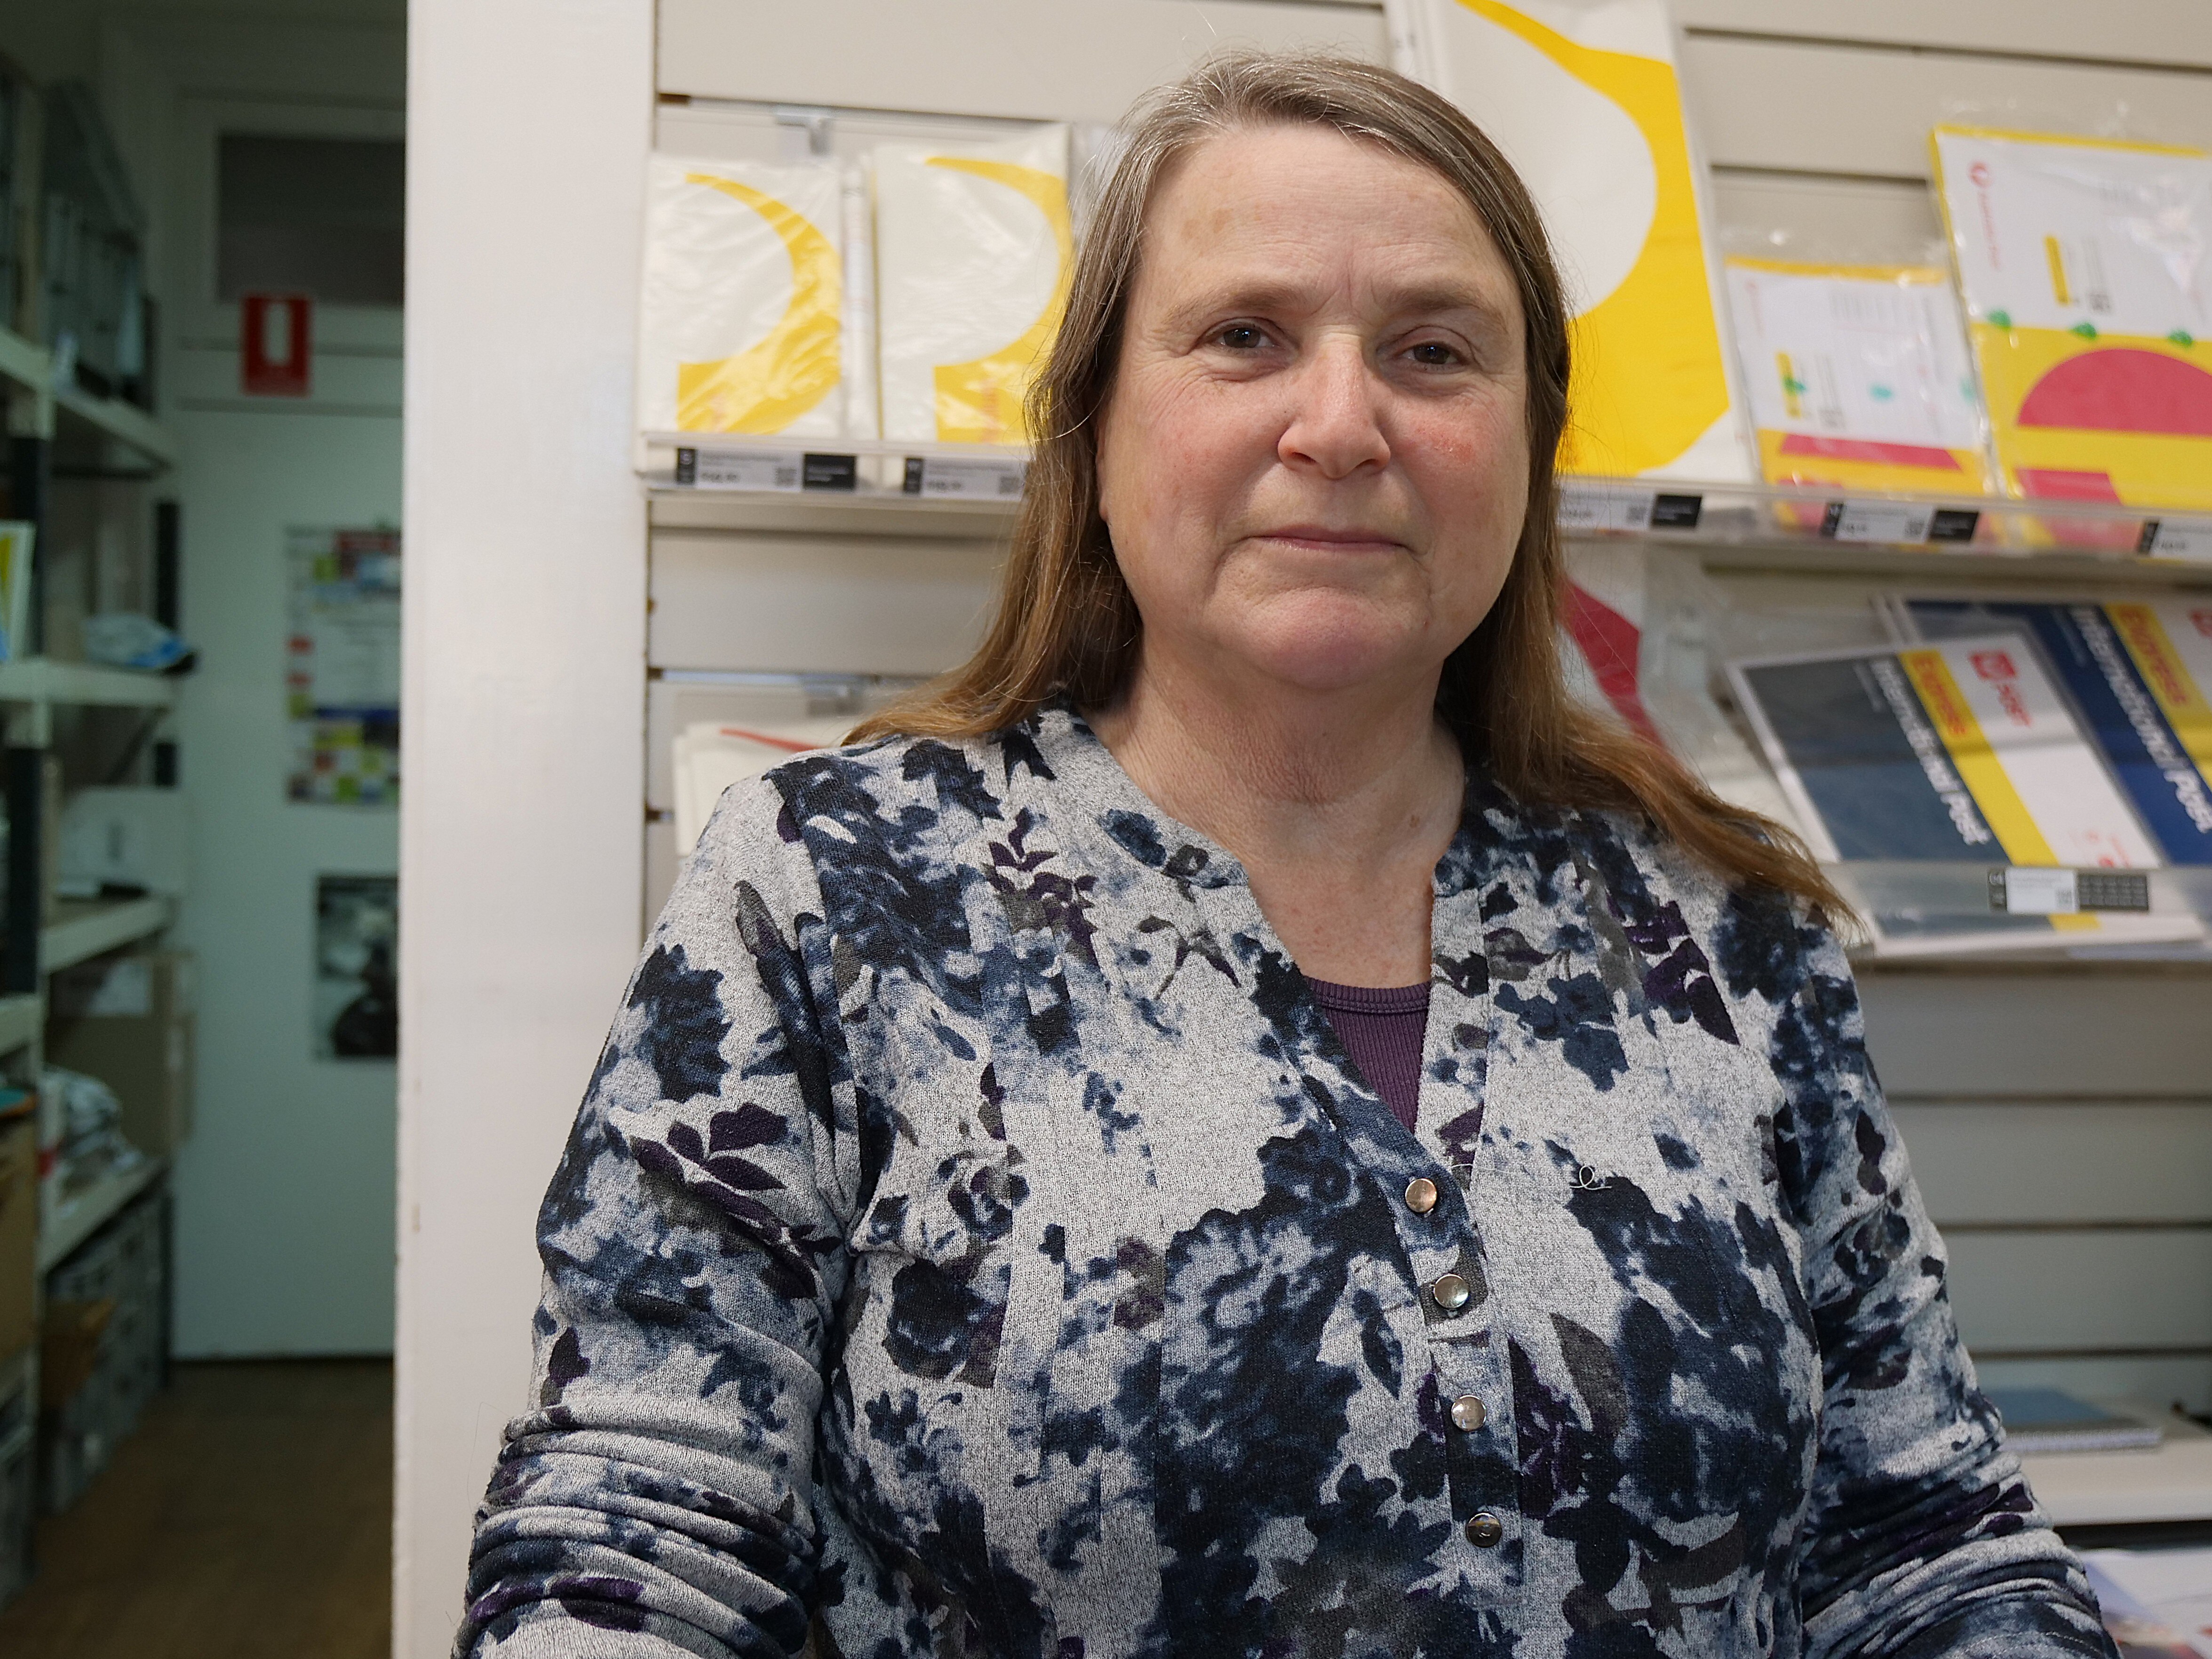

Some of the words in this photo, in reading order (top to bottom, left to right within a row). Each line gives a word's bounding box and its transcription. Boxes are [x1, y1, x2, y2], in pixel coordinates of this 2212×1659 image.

[1869, 660, 1961, 792] International
[1940, 790, 1993, 846] Post
[2068, 607, 2190, 771] International
[2163, 767, 2212, 834] Post
